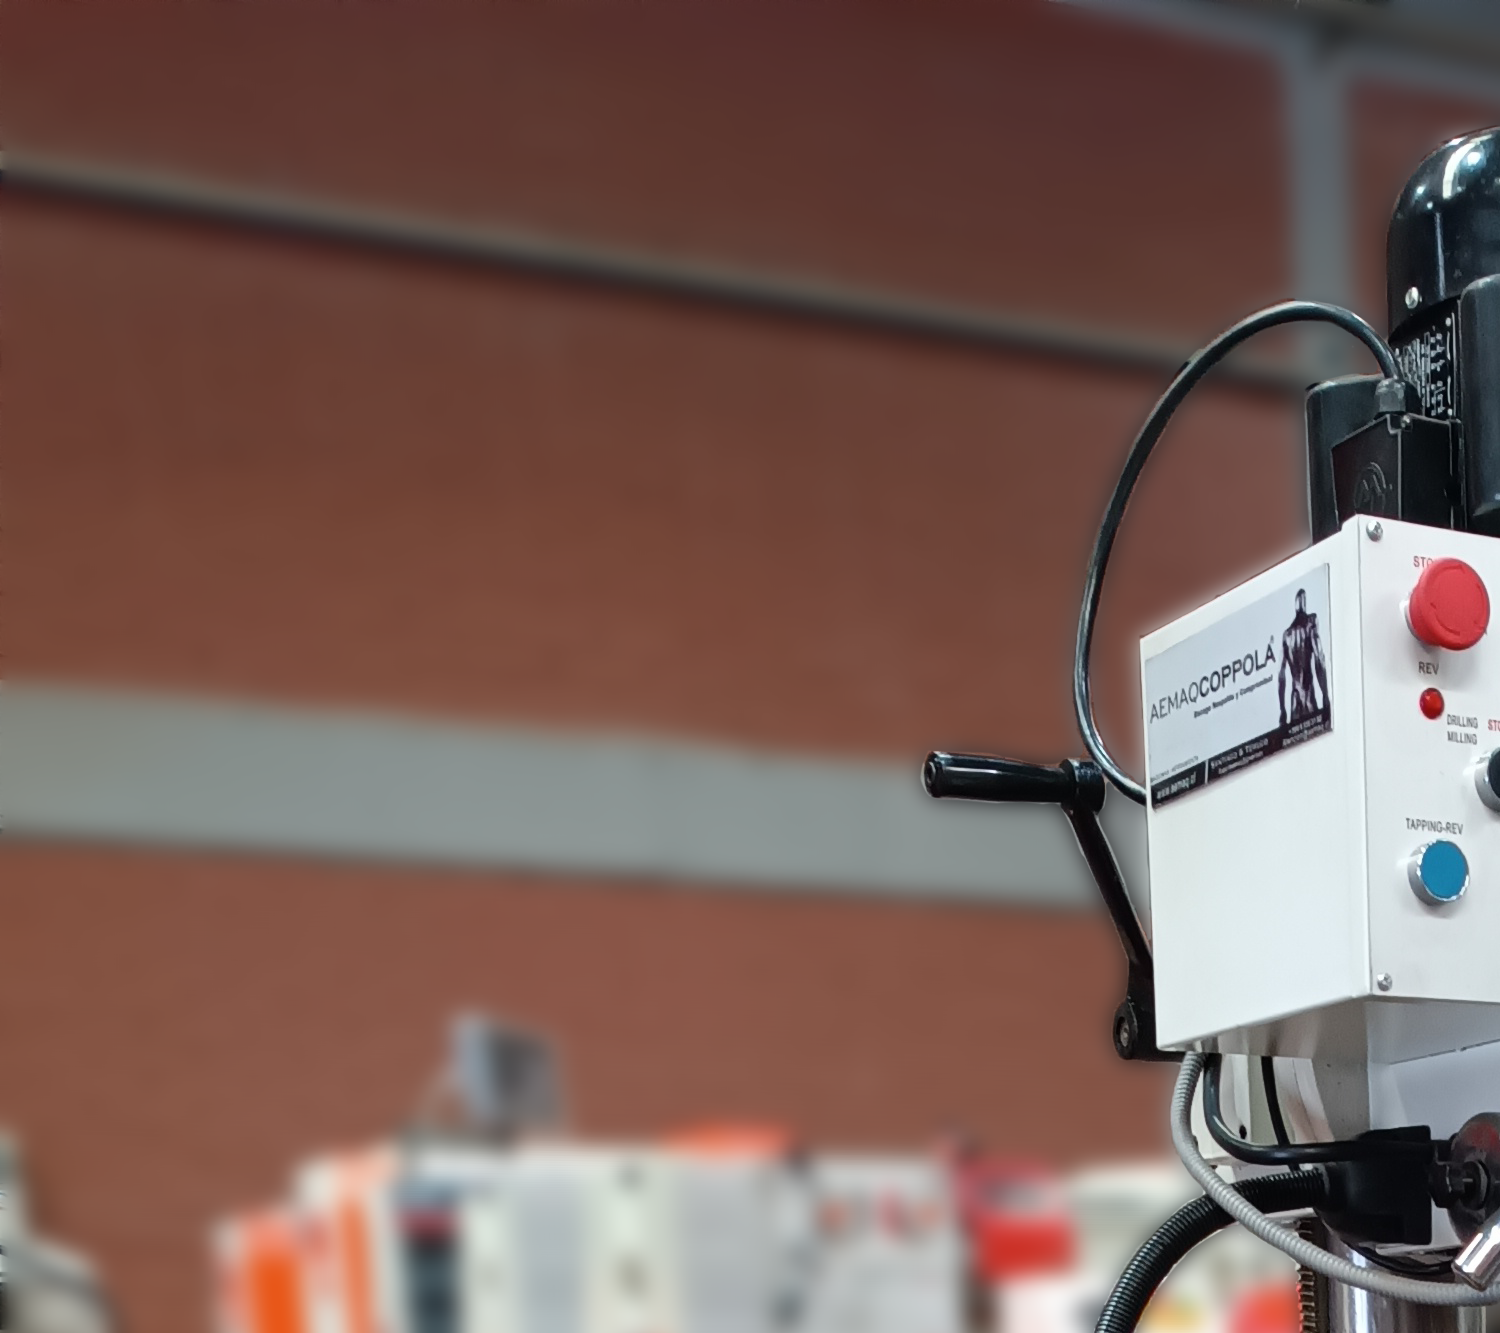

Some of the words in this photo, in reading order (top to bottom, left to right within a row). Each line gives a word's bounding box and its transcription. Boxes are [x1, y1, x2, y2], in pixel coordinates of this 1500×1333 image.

[1418, 661, 1440, 675] REV
[1446, 714, 1479, 729] DRILLING
[1447, 731, 1478, 745] MILLING
[1405, 818, 1464, 835] TAPPING-REV
